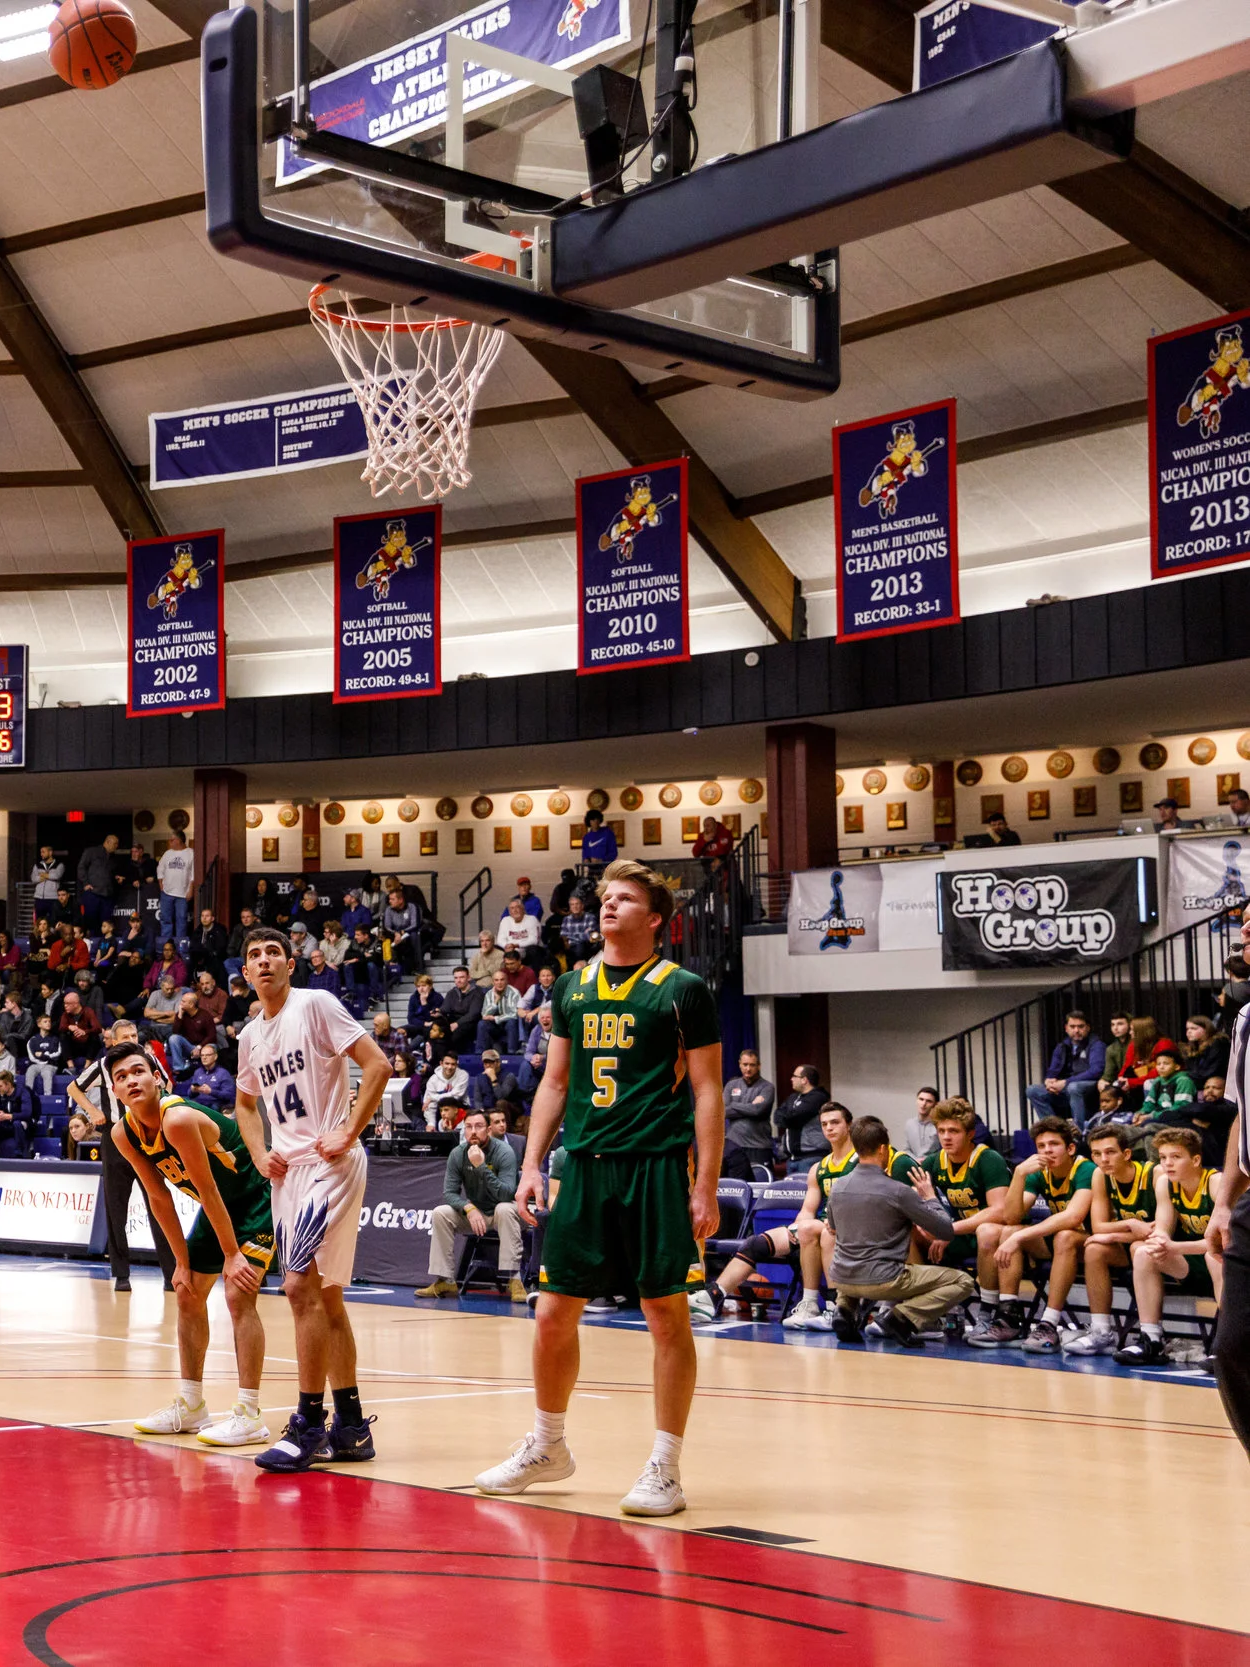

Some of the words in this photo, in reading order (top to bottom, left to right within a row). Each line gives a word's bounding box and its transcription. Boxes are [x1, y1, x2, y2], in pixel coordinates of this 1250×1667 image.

[370, 38, 442, 85] JERSEY
[183, 415, 220, 431] MEN'S
[223, 407, 269, 426] SOCCER
[1172, 439, 1221, 461] WOMEN'S
[1160, 467, 1191, 483] NJCAA
[1193, 459, 1213, 475] DIV.
[1214, 455, 1227, 470] III
[851, 525, 880, 539] MEN'S
[881, 512, 939, 533] BASKETBALL
[1189, 495, 1250, 532] 2013
[844, 542, 872, 557] NJCAA
[873, 538, 891, 551] DIV.
[892, 535, 903, 548] III
[904, 526, 947, 545] NATIONAL
[1165, 535, 1231, 560] RECORD:
[845, 540, 948, 576] CHAMPIONS
[611, 563, 653, 578] SOFTBALL
[585, 585, 611, 597] NJCAA
[611, 581, 628, 593] DIV.
[629, 579, 639, 590] III
[639, 573, 680, 588] NATIONAL
[869, 570, 923, 602] 2013
[366, 601, 408, 613] SOFTBALL
[585, 586, 681, 614] CHAMPIONS
[342, 619, 367, 630] NJCAA
[367, 616, 383, 628] DIV.
[383, 615, 393, 625] III
[394, 612, 432, 625] NATIONAL
[854, 605, 913, 626] RECORD:
[915, 599, 941, 616] 33-1
[157, 620, 194, 632] SOFTBALL
[342, 624, 433, 647] CHAMPIONS
[607, 612, 658, 639] 2010
[134, 637, 157, 648] NJCAA
[157, 635, 172, 646] DIV.
[172, 634, 182, 644] III
[182, 630, 216, 643] NATIONAL
[590, 642, 644, 661] RECORD:
[645, 638, 676, 653] 45-10
[134, 642, 217, 664] CHAMPIONS
[362, 647, 412, 671] 2005
[153, 664, 198, 687] 2002
[344, 675, 396, 690] RECORD:
[398, 672, 430, 686] 49-8-1
[140, 690, 188, 705] RECORD:
[188, 688, 211, 700] 47-9
[953, 874, 1068, 918] Hoop
[1184, 896, 1224, 911] Hoop
[800, 918, 829, 931] Hoop
[829, 917, 864, 929] Group
[981, 911, 1114, 955] Group
[582, 1013, 635, 1049] RBC
[591, 1056, 619, 1108] 5
[273, 1081, 308, 1125] 14
[3, 1189, 95, 1212] BROOKDALE
[716, 1187, 745, 1195] OOKDALE
[772, 1189, 807, 1197] BROOKDAL
